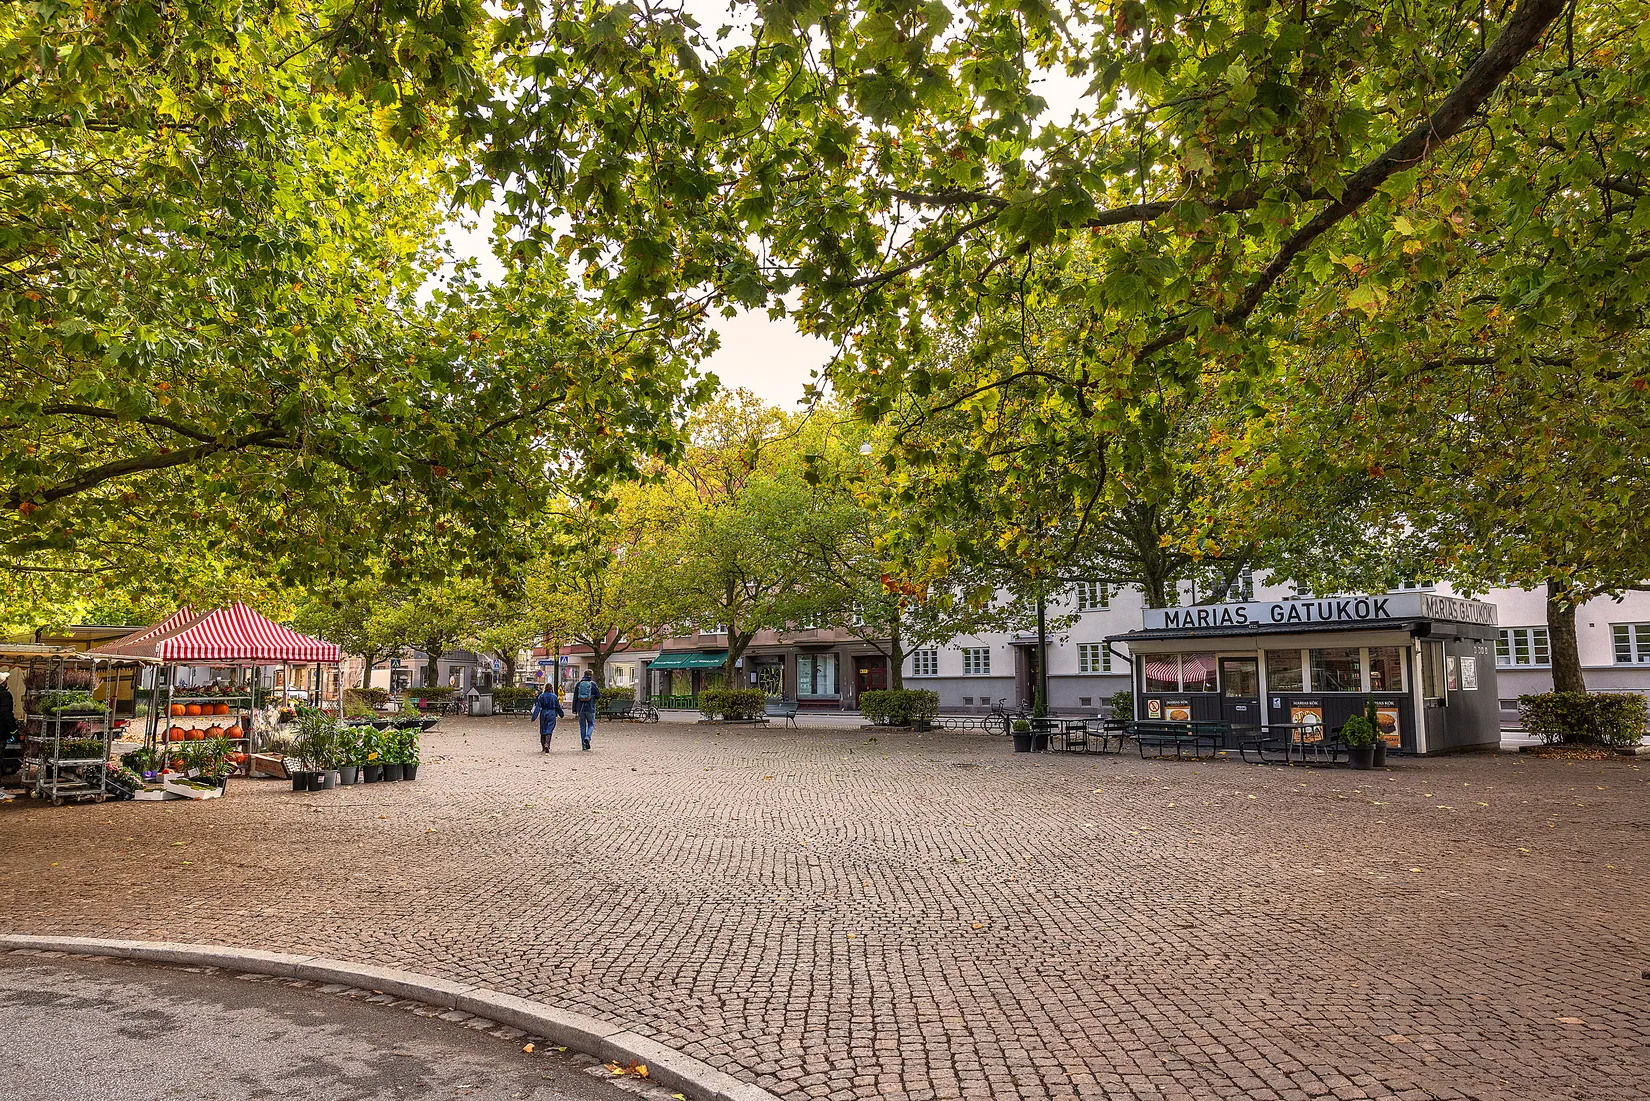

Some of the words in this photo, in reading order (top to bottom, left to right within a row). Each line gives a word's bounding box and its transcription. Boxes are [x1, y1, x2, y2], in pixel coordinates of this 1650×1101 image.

[1164, 606, 1248, 628] MARIAS
[1270, 597, 1391, 624] GATUKÖK
[1426, 597, 1458, 619] MARIAS
[1460, 601, 1494, 624] GATUKÖK
